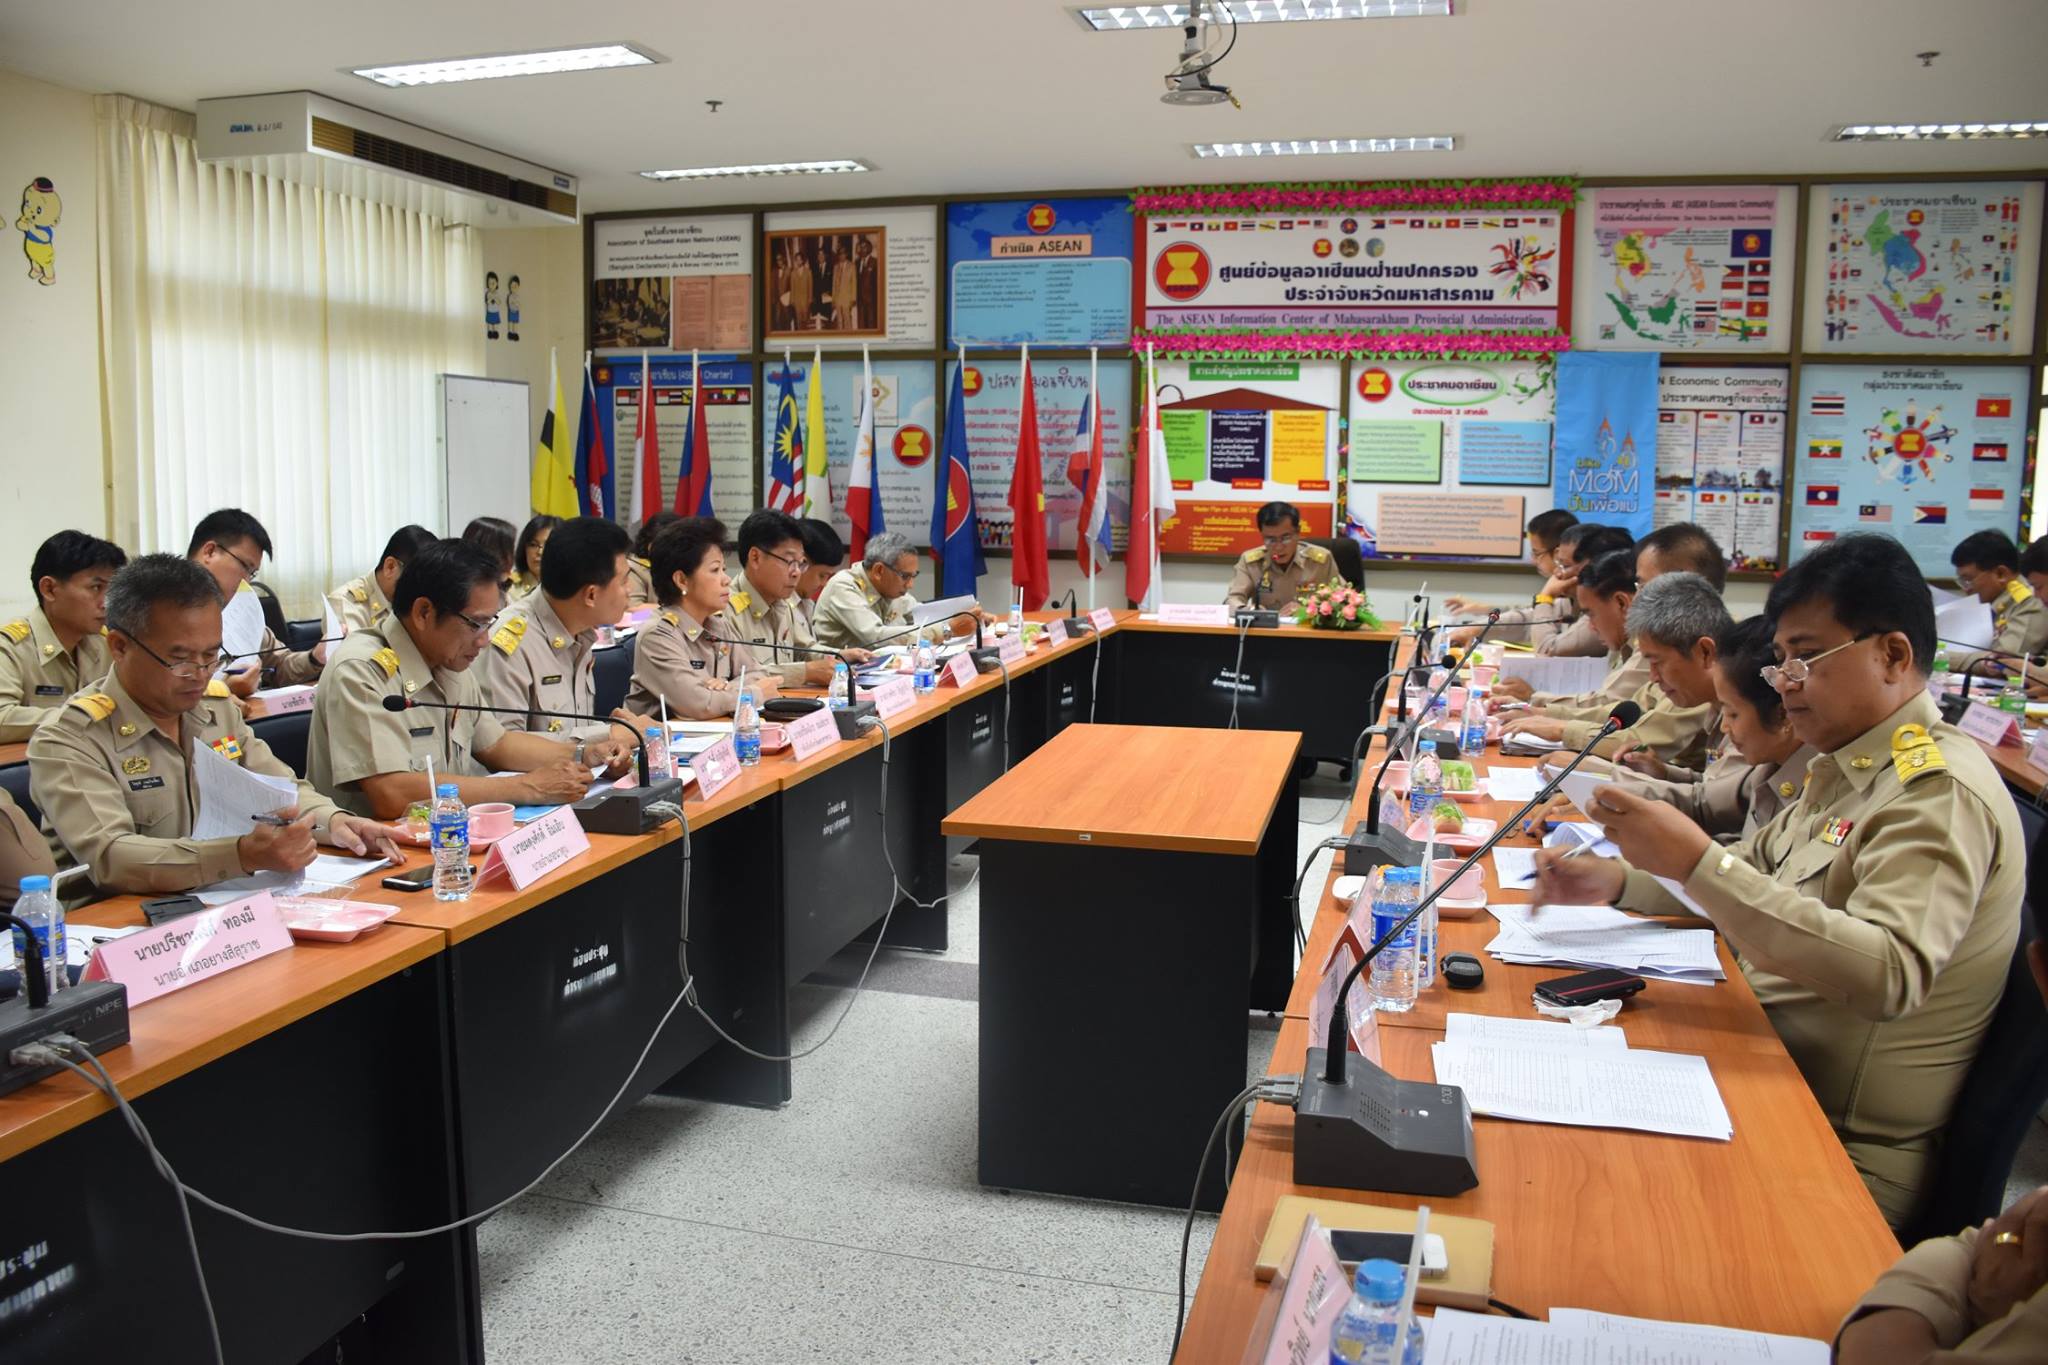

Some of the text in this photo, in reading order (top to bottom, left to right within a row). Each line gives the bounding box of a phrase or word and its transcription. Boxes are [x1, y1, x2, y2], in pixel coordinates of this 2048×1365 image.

[1038, 240, 1083, 252] ASEAN
[1219, 261, 1478, 282] ศูนย์ข้อมูลอาเซียนฝ่ายปกครอง
[1285, 285, 1494, 301] ประจำจังหวัดมหาสารคาม
[1156, 313, 1548, 326] The ASEAN Information Center of Mahasarakham Provincial Administration.
[1669, 376, 1720, 386] Economic
[1724, 377, 1783, 388] Community
[222, 905, 255, 930] ทองมี
[95, 998, 123, 1016] NPE
